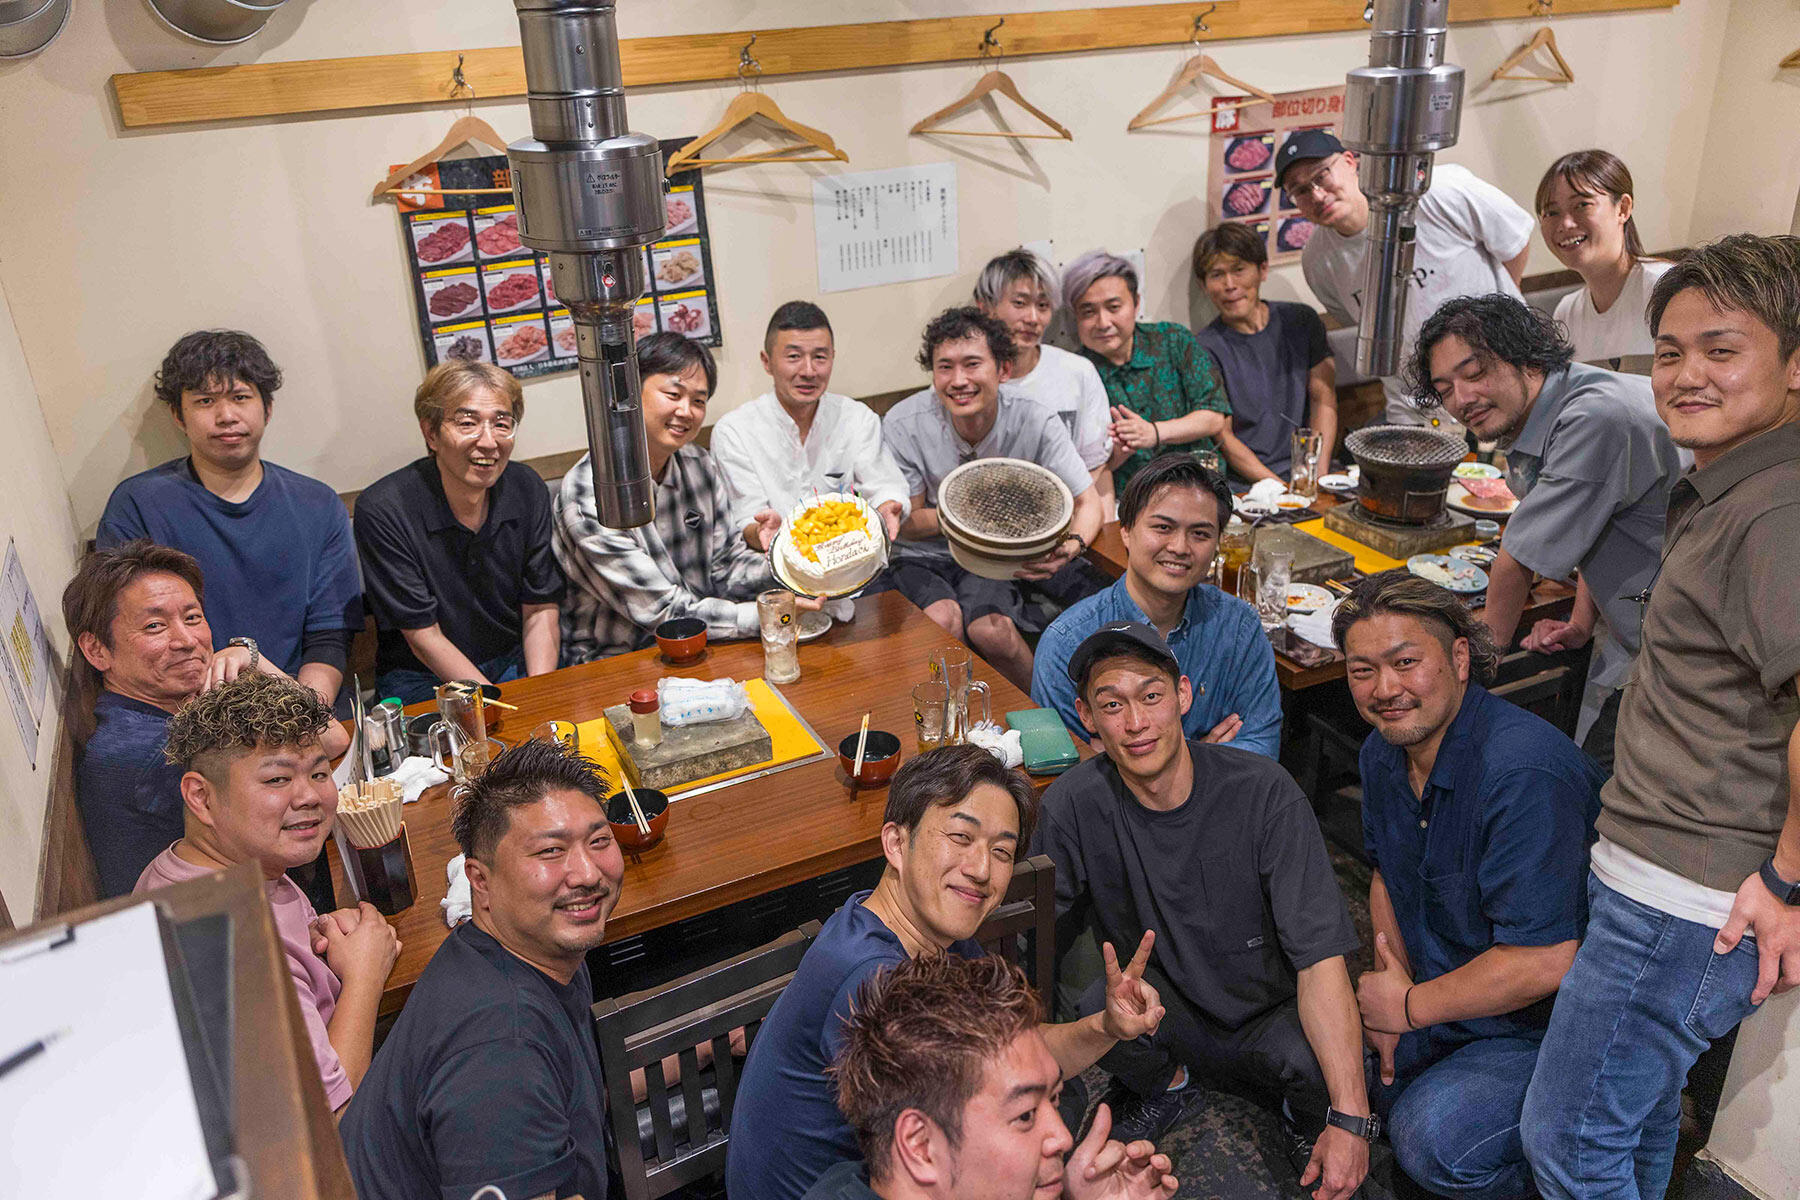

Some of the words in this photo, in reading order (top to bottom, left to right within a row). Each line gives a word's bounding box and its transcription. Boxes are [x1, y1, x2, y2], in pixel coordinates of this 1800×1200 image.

[1272, 95, 1346, 119] 部位切り身
